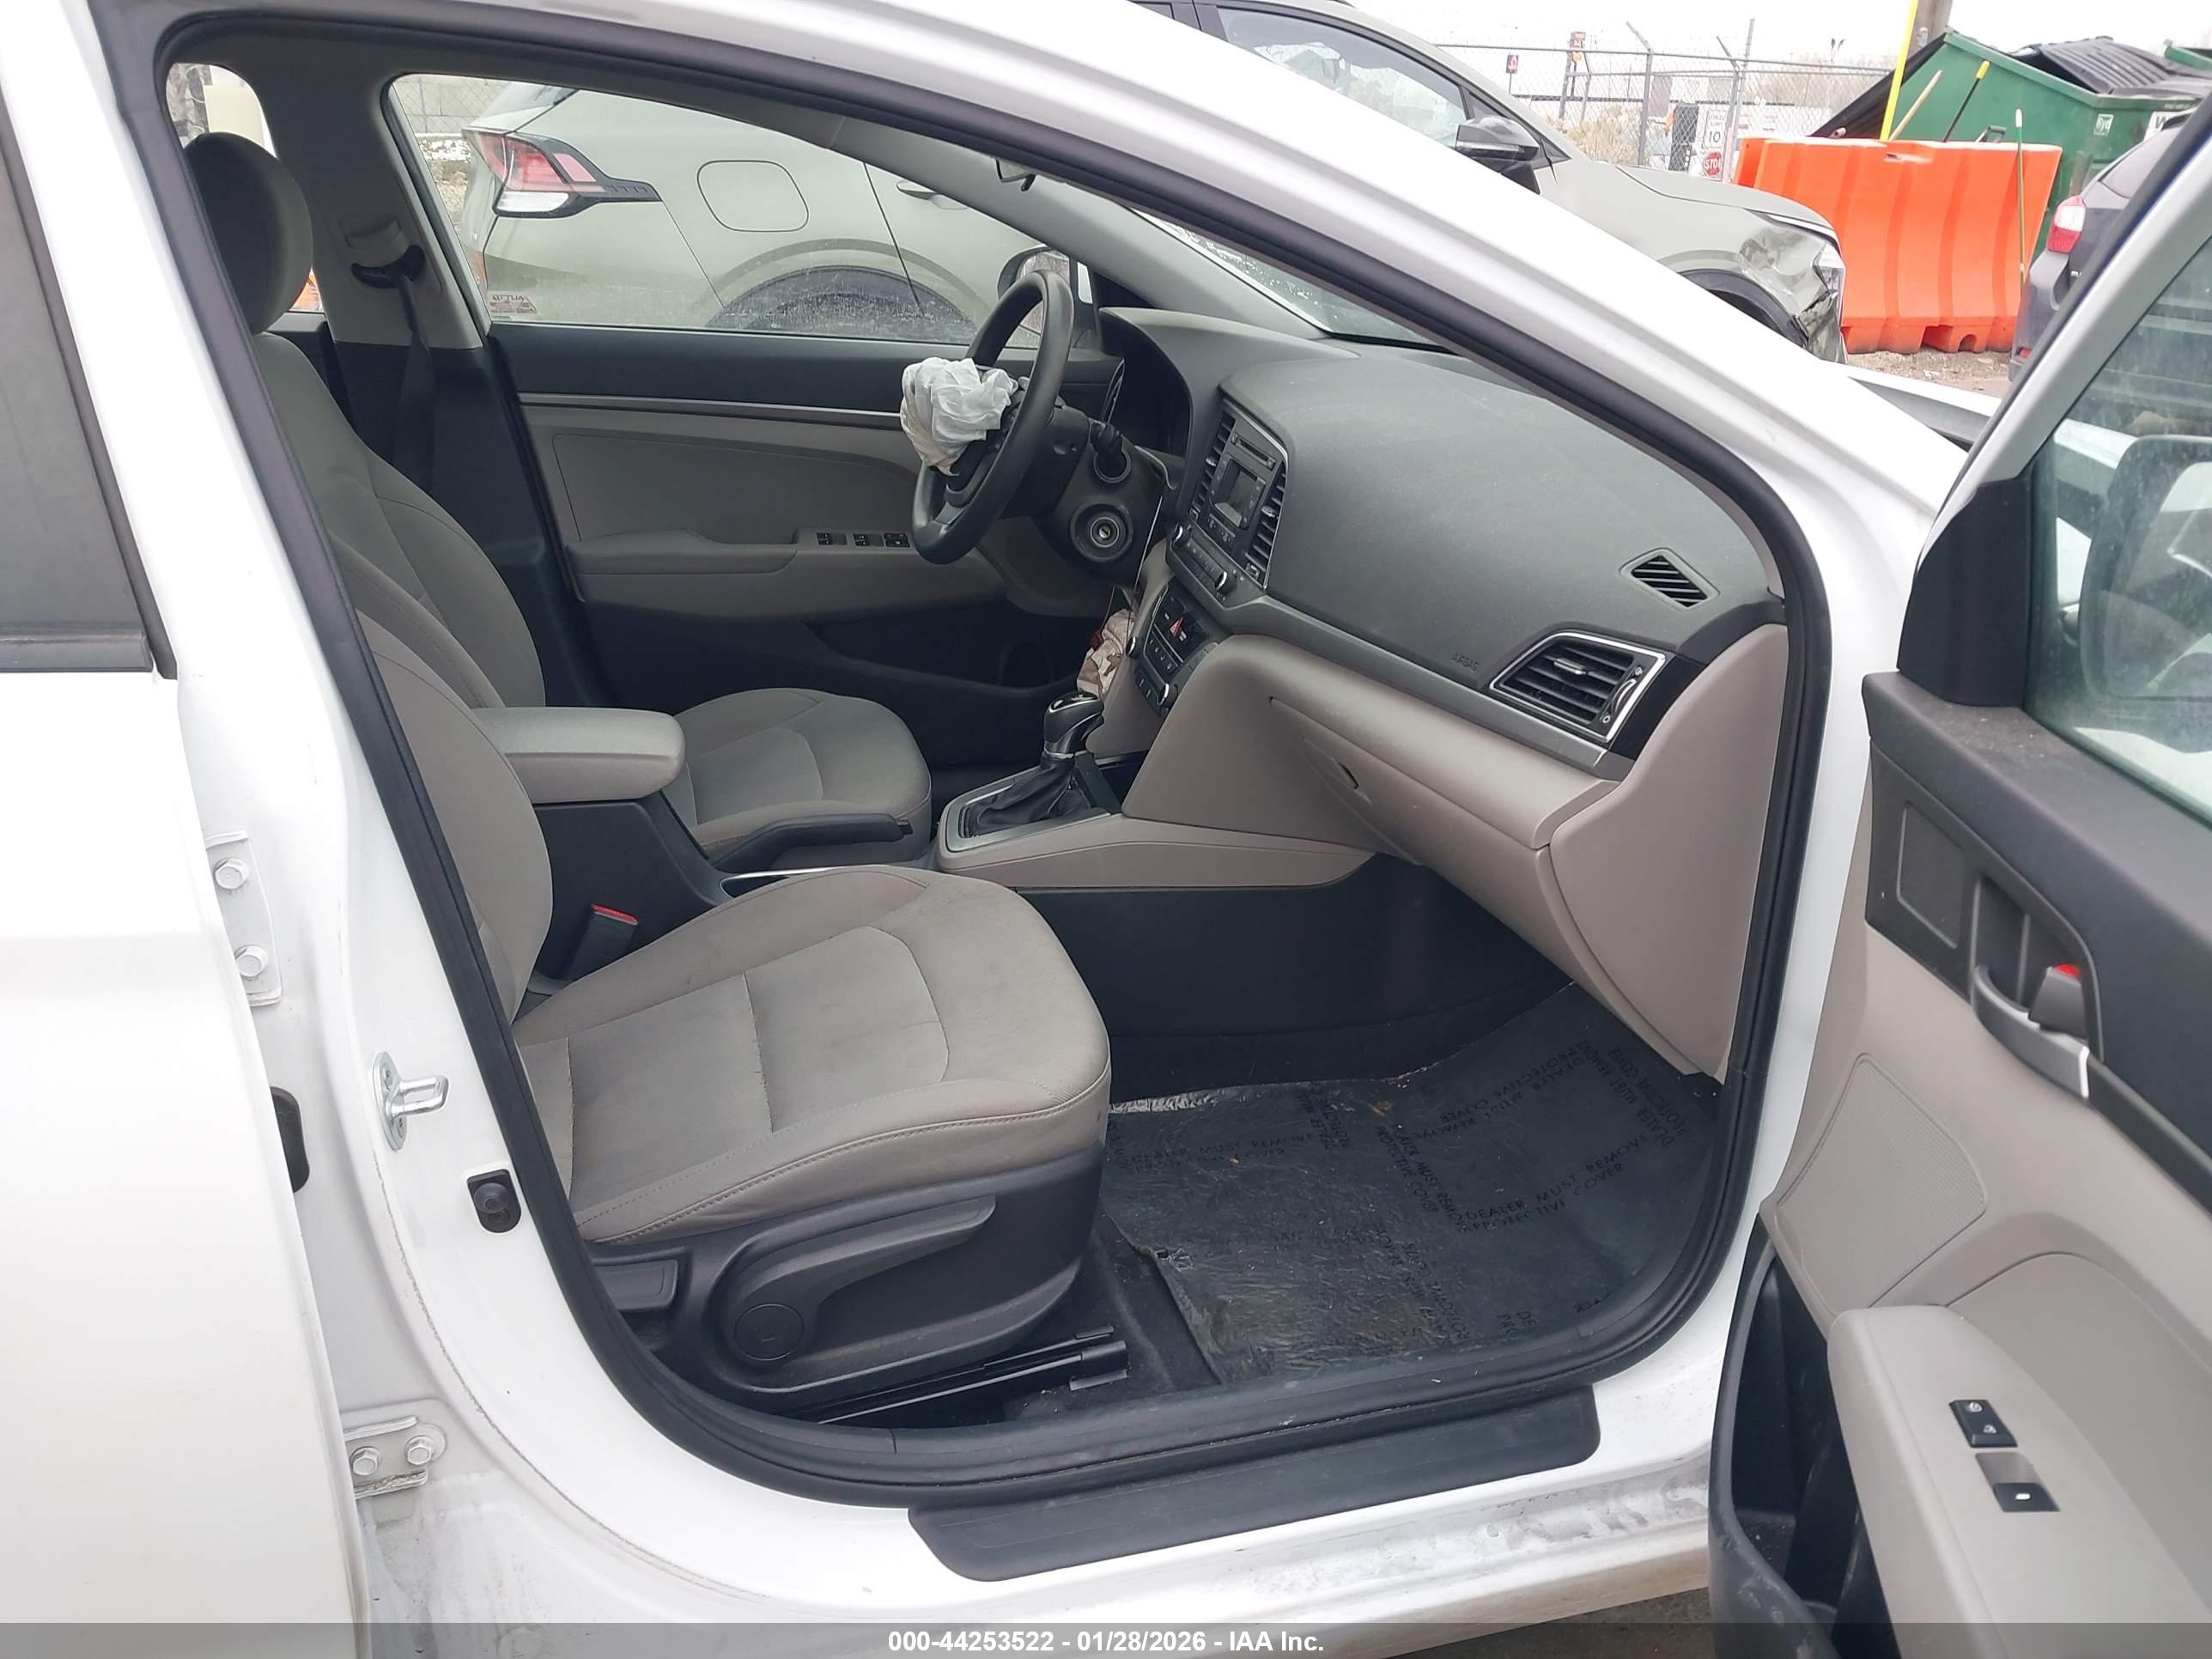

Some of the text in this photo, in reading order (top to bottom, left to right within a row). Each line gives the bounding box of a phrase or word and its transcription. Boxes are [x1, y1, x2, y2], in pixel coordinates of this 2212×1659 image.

[1709, 131, 1721, 143] 10
[1536, 1174, 1578, 1203] MUST
[1584, 1131, 1649, 1174] REMOVE
[1574, 1162, 1623, 1196] COVER
